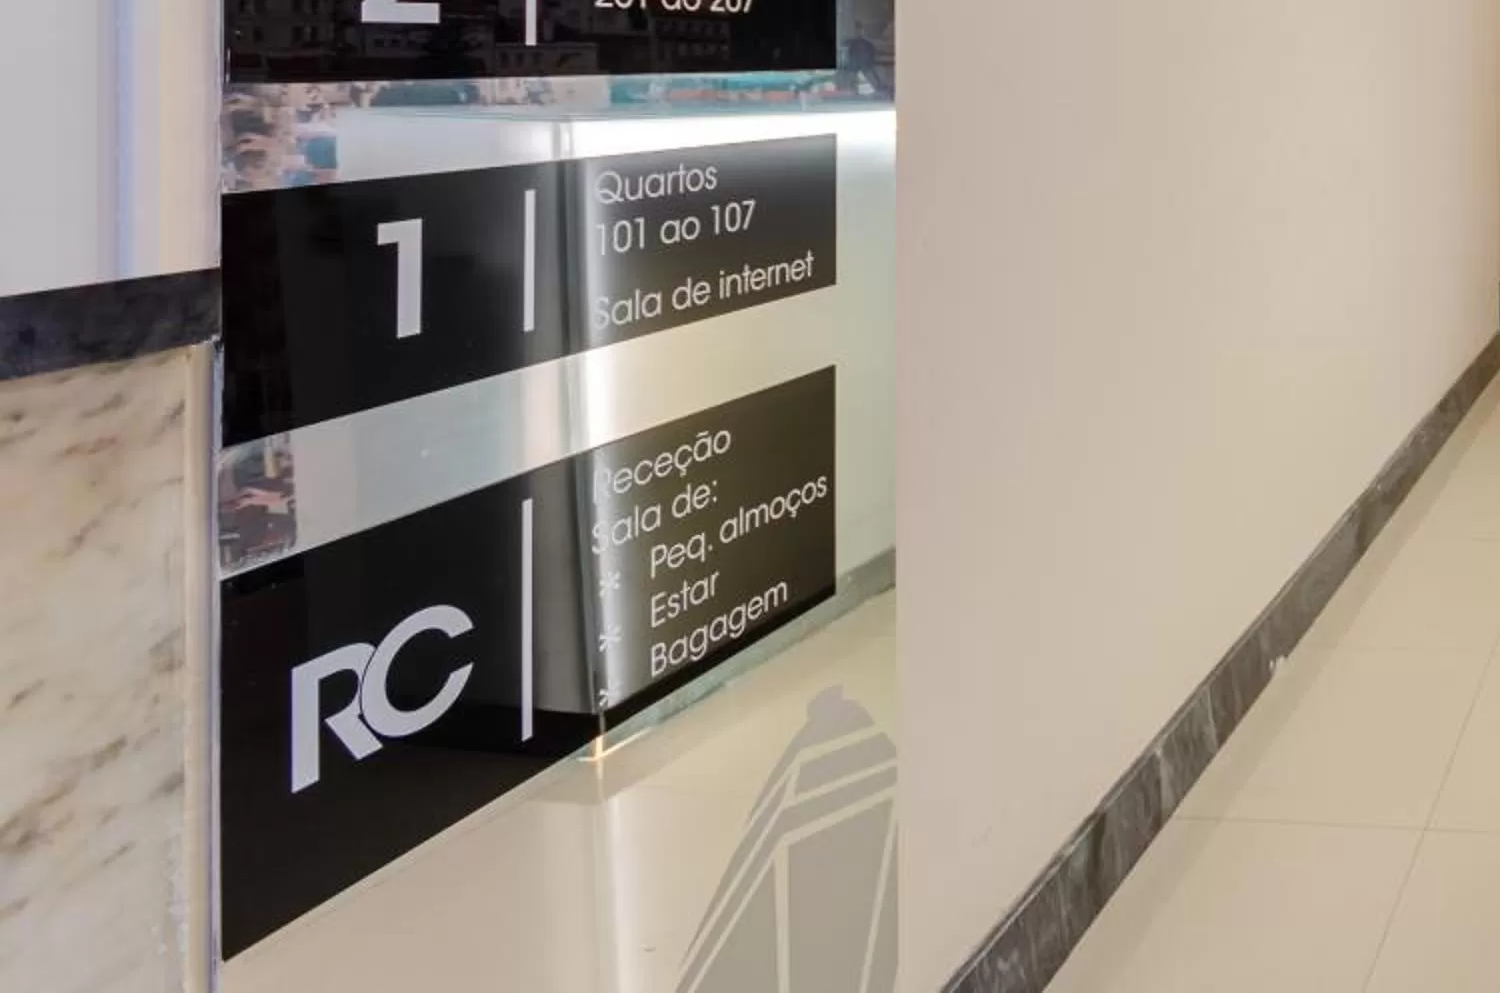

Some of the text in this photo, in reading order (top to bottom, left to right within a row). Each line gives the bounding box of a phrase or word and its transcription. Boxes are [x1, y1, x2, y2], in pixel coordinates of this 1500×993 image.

[594, 162, 718, 205] Quartos
[596, 198, 756, 256] 101 ao 107
[376, 216, 423, 339] 1
[594, 248, 815, 330] Sala de internet
[593, 428, 731, 504] Receção
[591, 479, 718, 556] Sala de:
[650, 475, 828, 580] Peq. almoços
[650, 570, 720, 629] Estar
[650, 580, 789, 679] Bagagem
[291, 604, 474, 794] RC
